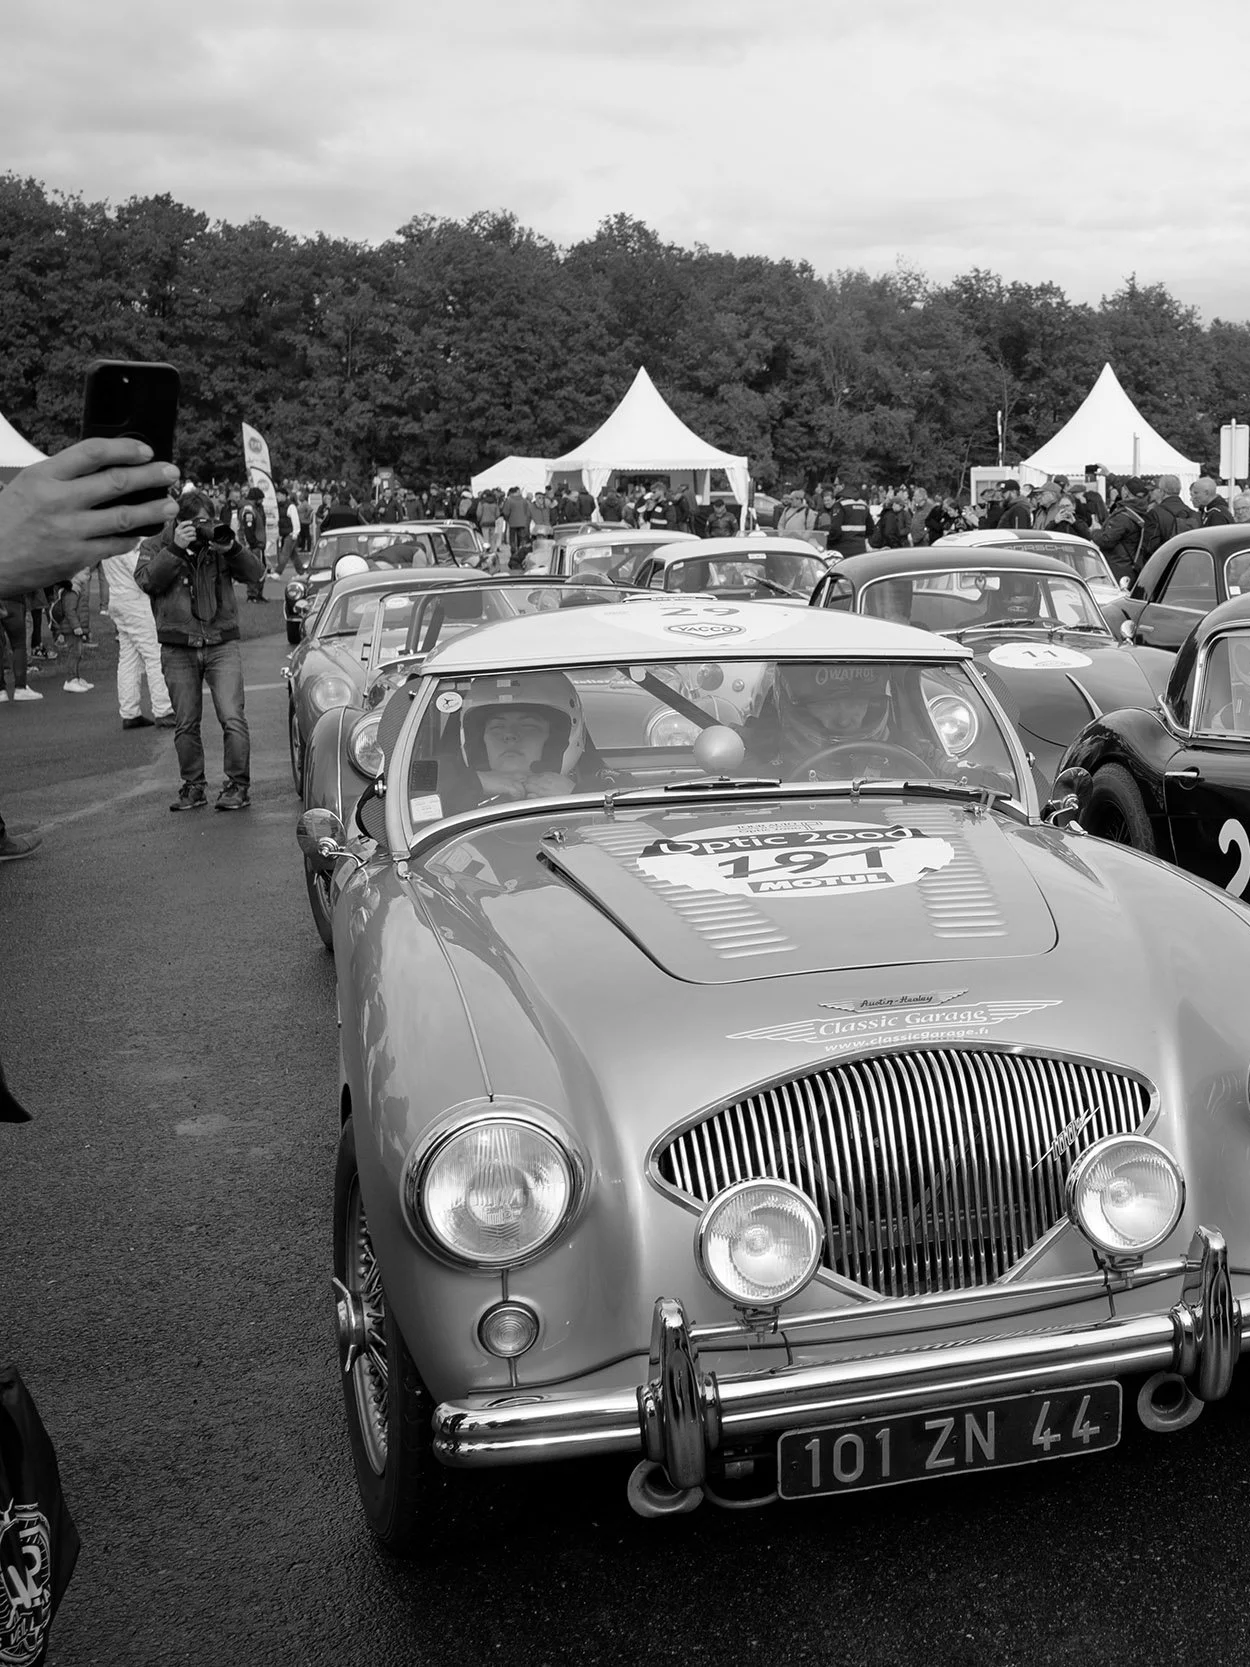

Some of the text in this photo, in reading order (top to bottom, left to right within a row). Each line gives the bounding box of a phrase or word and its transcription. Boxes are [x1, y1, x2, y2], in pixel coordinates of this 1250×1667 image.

[660, 607, 740, 616] 29
[659, 826, 914, 854] Optic 2000
[757, 873, 887, 892] MOTUL
[819, 1009, 988, 1036] Classic Garage
[805, 1395, 1100, 1488] 101 ZN 44
